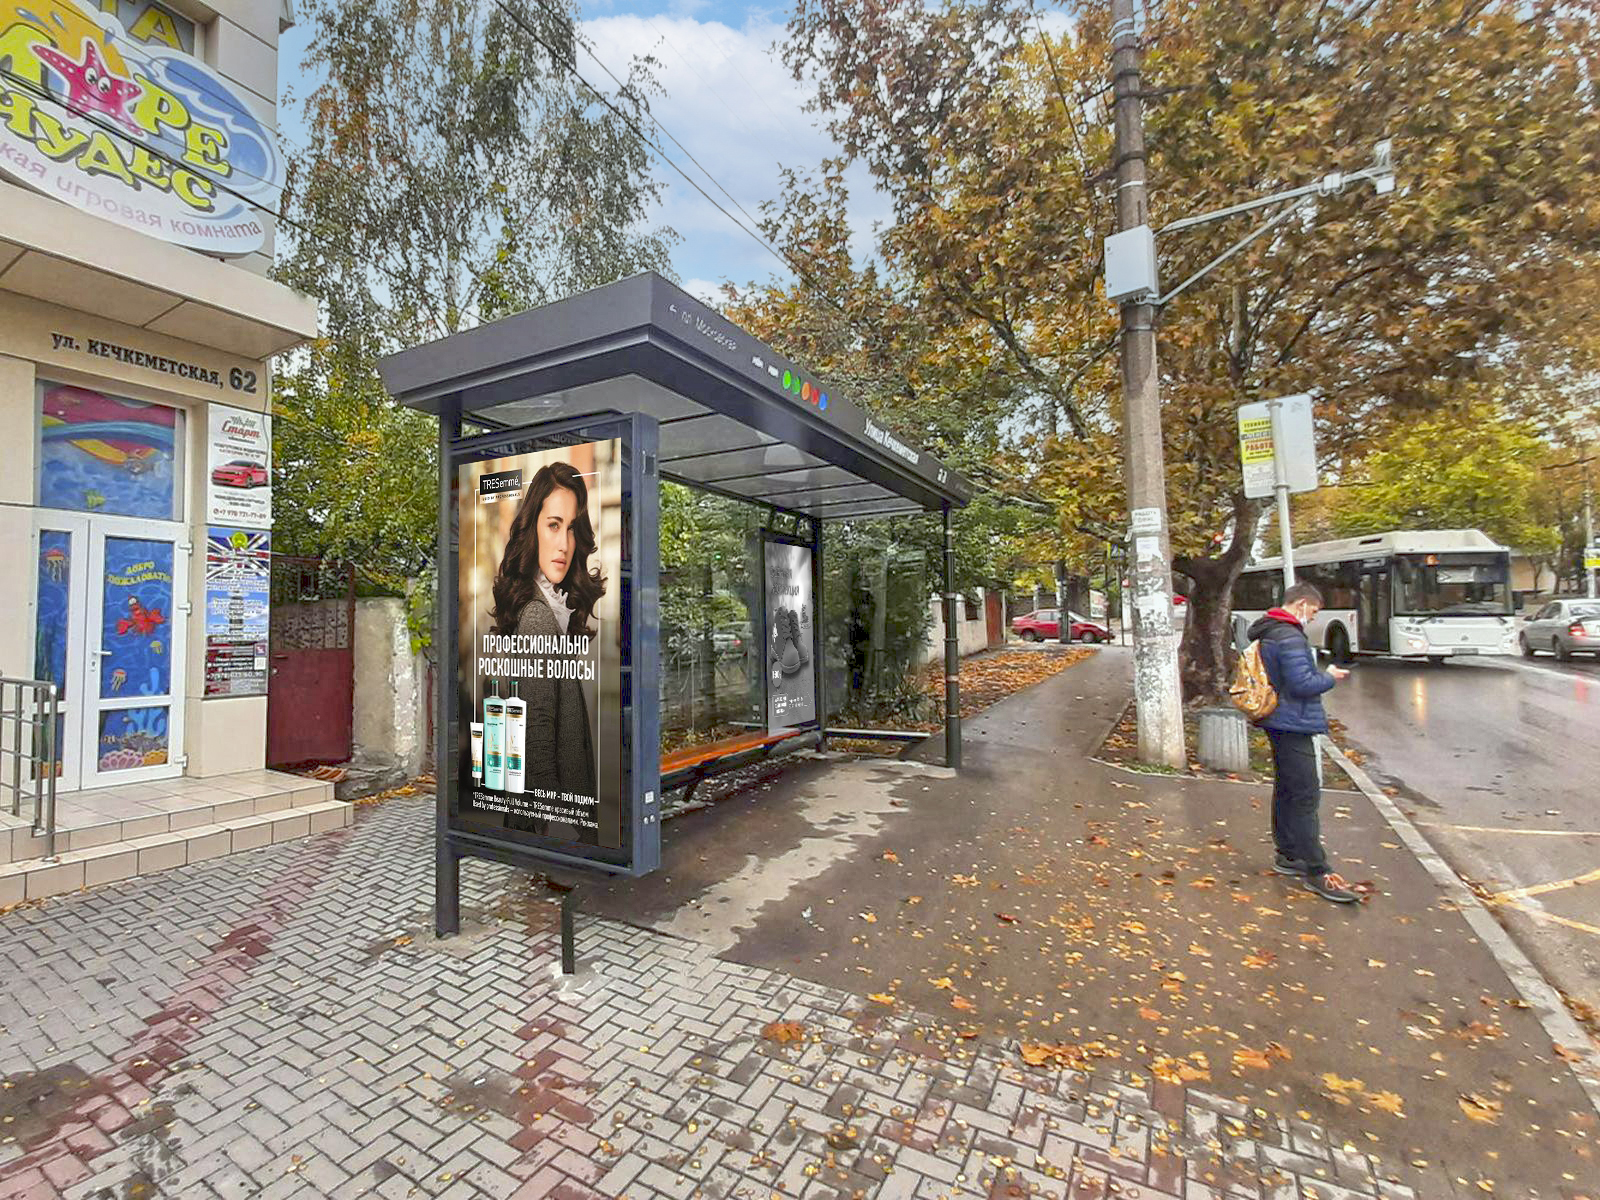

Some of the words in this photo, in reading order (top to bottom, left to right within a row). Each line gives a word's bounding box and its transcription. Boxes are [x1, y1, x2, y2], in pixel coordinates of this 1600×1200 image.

[56, 176, 163, 229] игровая
[170, 218, 263, 240] комната
[51, 332, 81, 350] ул.
[87, 338, 224, 390] КЕЧКЕМЕТСКАЯ,
[229, 367, 257, 394] 62
[482, 474, 519, 490] TRESemmé
[483, 634, 590, 656] ПРОФЕССИОНАЛЬНО
[478, 657, 544, 679] РОСКОШНЫЕ
[547, 659, 595, 681] ВОЛОСЫ
